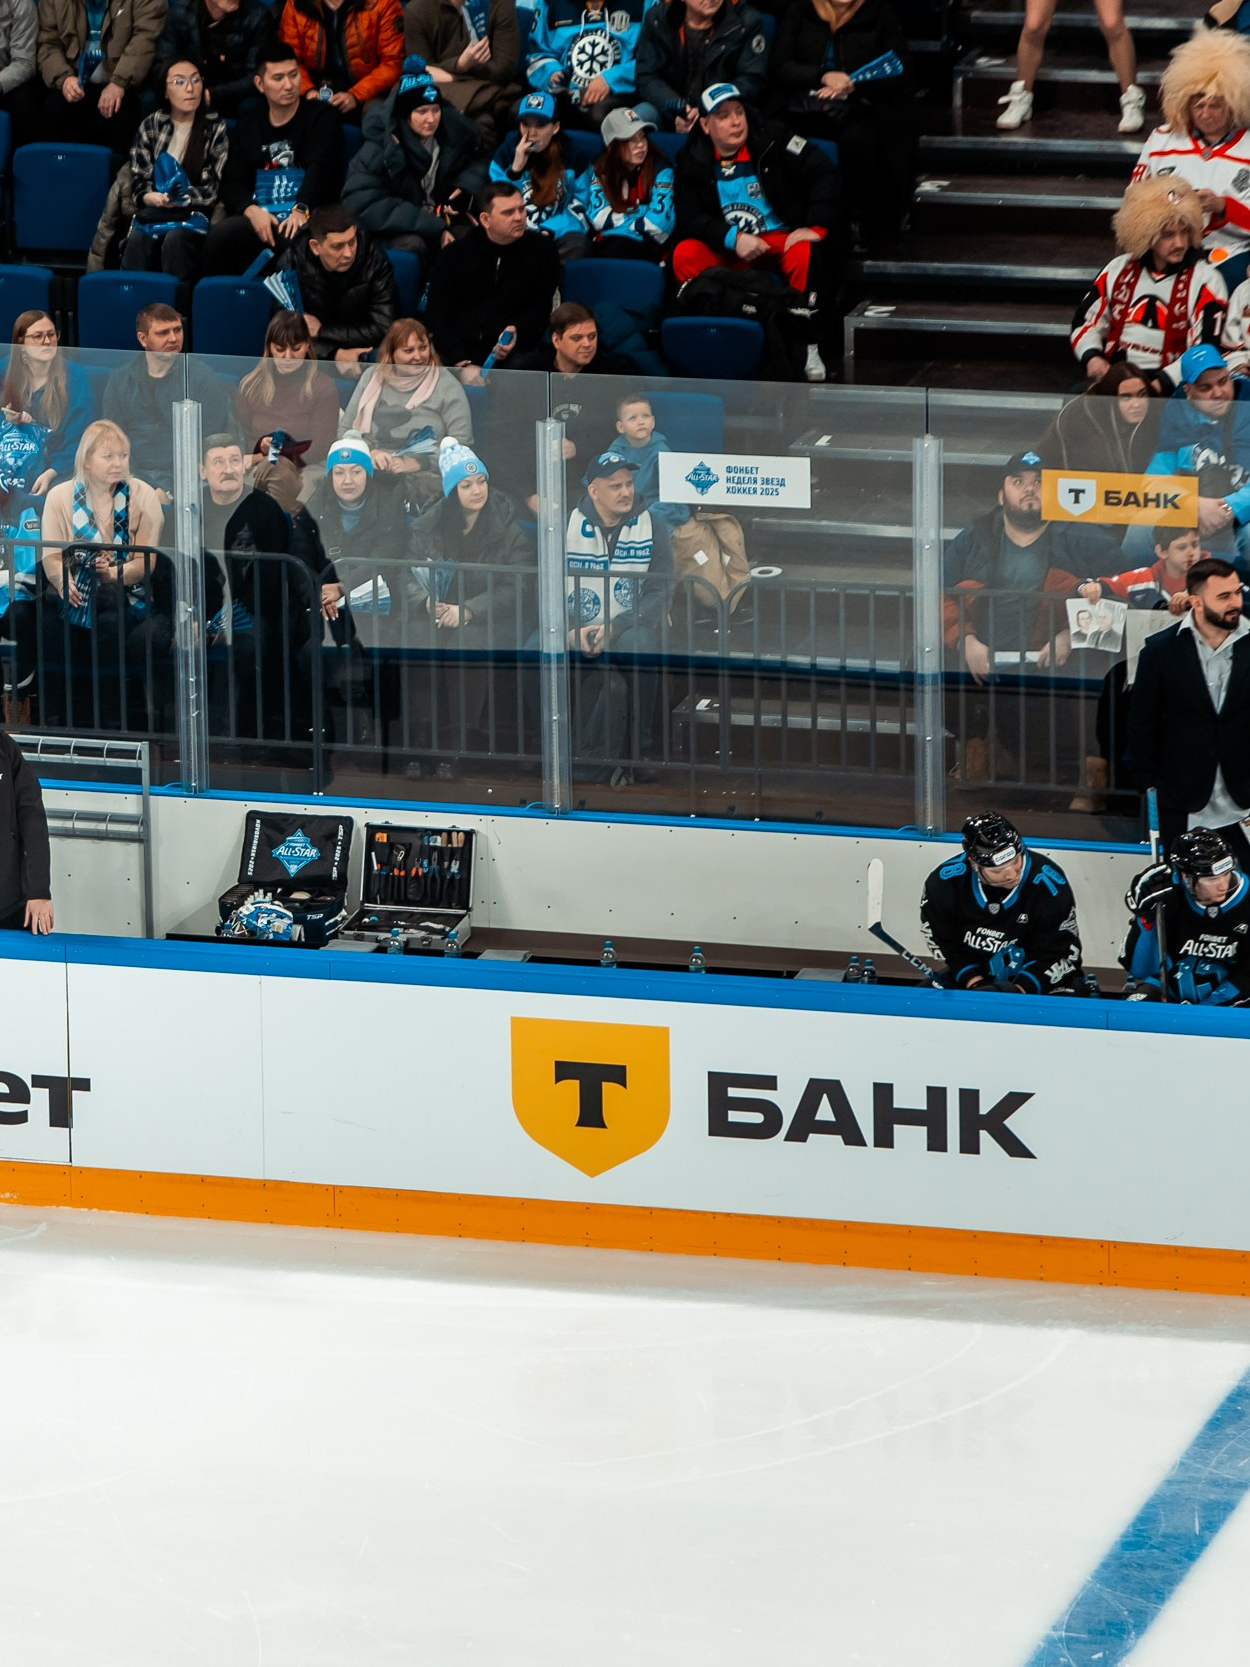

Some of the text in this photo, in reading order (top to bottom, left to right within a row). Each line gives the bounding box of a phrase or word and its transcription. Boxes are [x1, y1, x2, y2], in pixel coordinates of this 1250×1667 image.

[726, 465, 759, 474] ФОНБЕТ
[726, 476, 786, 487] НЕДЕЛЯ ЗВЕЗД
[726, 486, 780, 496] ХОККЕЯ 2025
[1104, 489, 1181, 510] БАНК
[306, 913, 324, 921] TSP
[976, 927, 1006, 940] FONBET
[1198, 933, 1228, 943] FONBET
[707, 1070, 1038, 1159] БАНК
